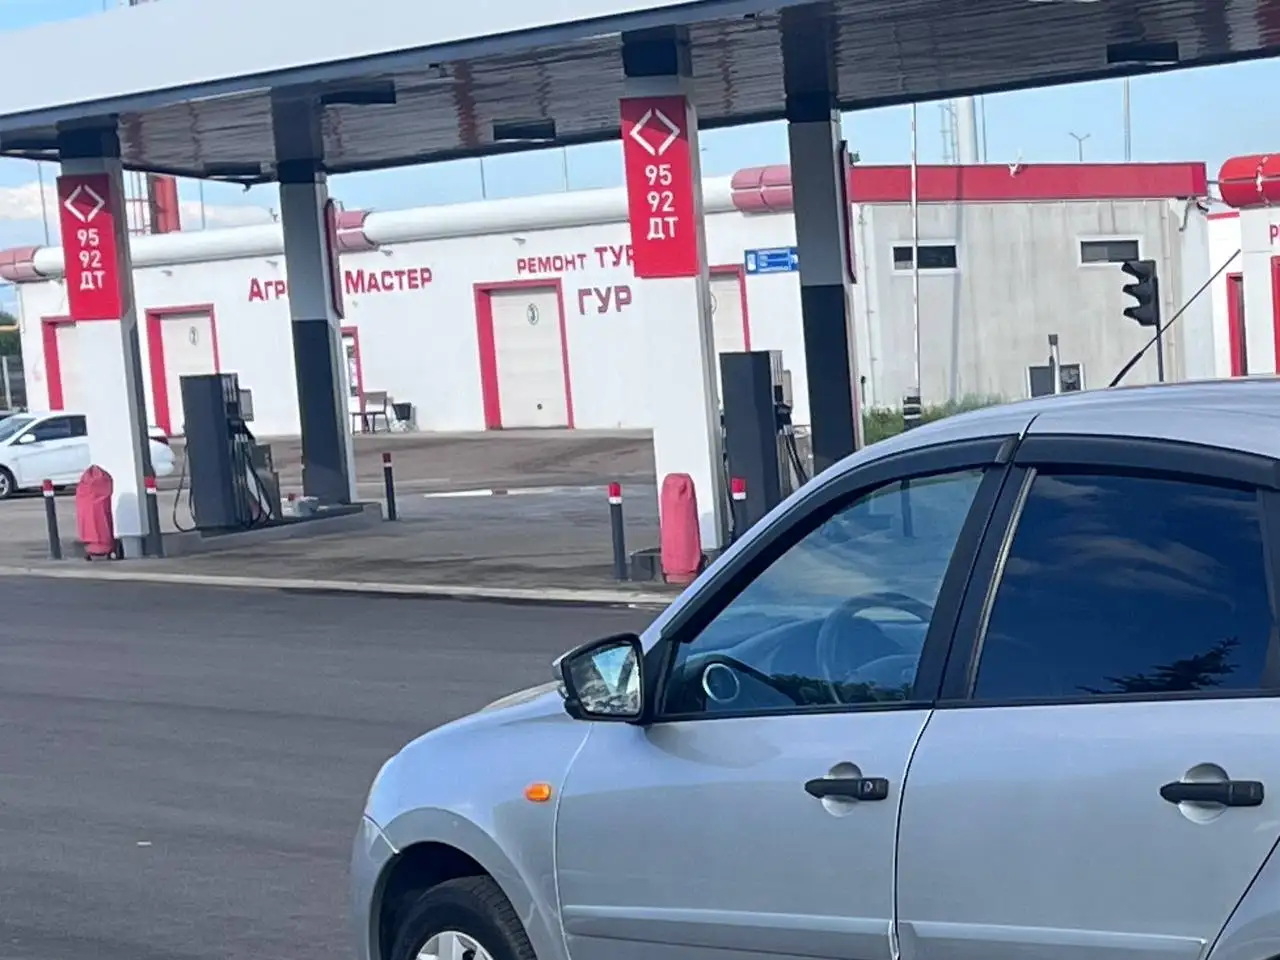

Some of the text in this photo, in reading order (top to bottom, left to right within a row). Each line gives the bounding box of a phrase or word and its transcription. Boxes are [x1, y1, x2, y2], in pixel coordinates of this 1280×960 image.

[645, 165, 673, 186] 95
[646, 191, 675, 213] 92
[77, 229, 99, 247] 95
[647, 217, 679, 240] ДТ
[79, 251, 102, 269] 92
[517, 244, 635, 274] РЕМОНТ ТУР
[80, 271, 105, 291] ДТ
[248, 277, 286, 302] АГР
[578, 285, 632, 315] ГУР
